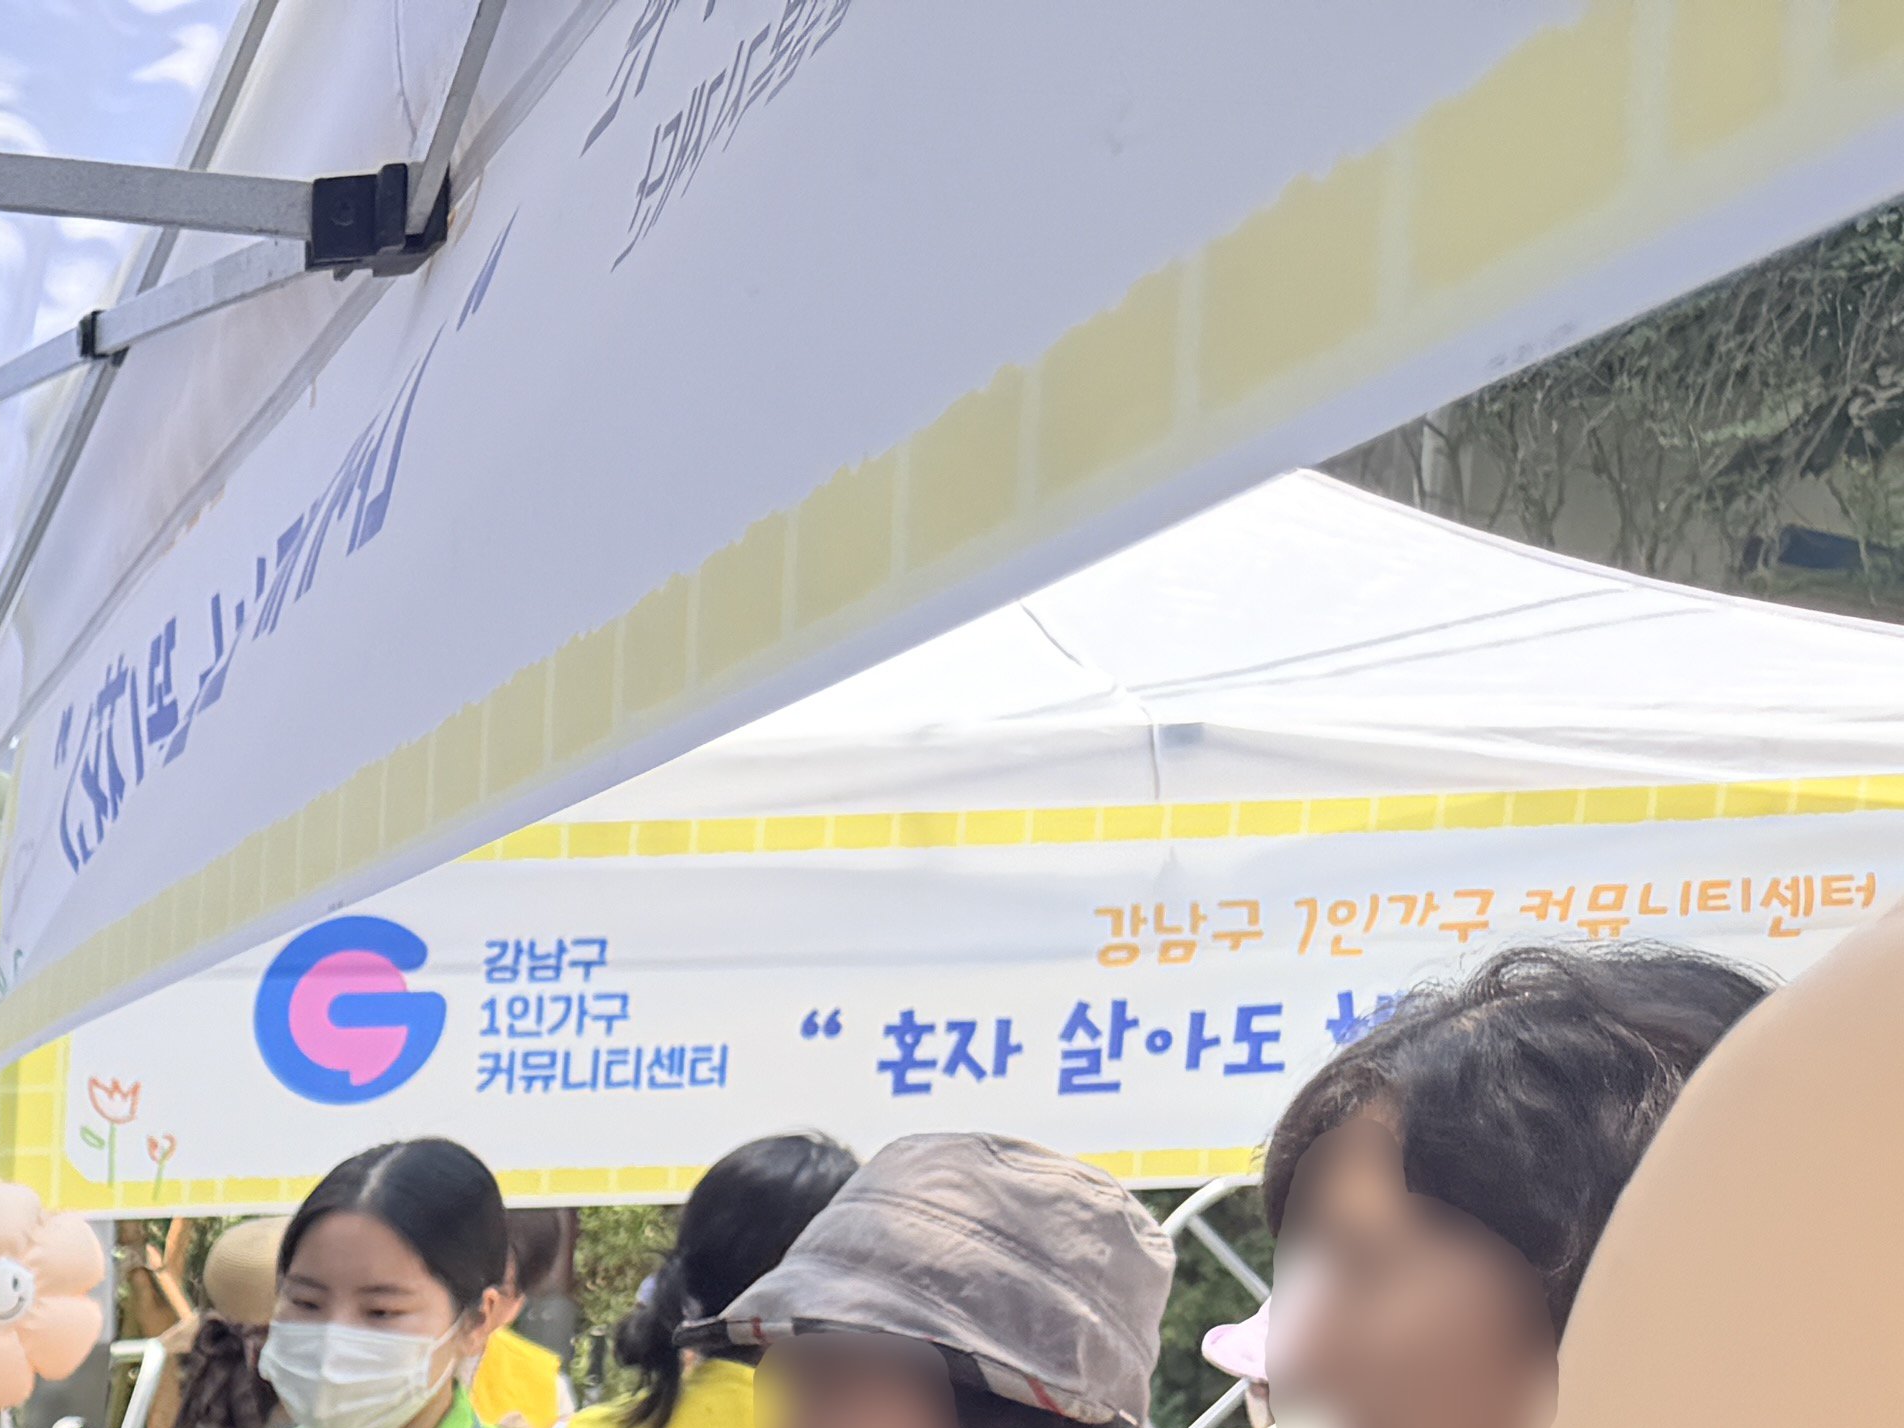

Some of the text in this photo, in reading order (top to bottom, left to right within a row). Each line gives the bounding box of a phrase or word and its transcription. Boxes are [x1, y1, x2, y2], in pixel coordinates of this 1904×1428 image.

[1093, 872, 1878, 967] 강남구 1인가구 커뮤니티센터
[483, 937, 608, 982] 강남구
[479, 992, 630, 1038] 1인가구
[475, 1043, 729, 1094] 커뮤니티센터
[876, 1009, 1023, 1096] 혼자
[1058, 998, 1286, 1095] 살아도
